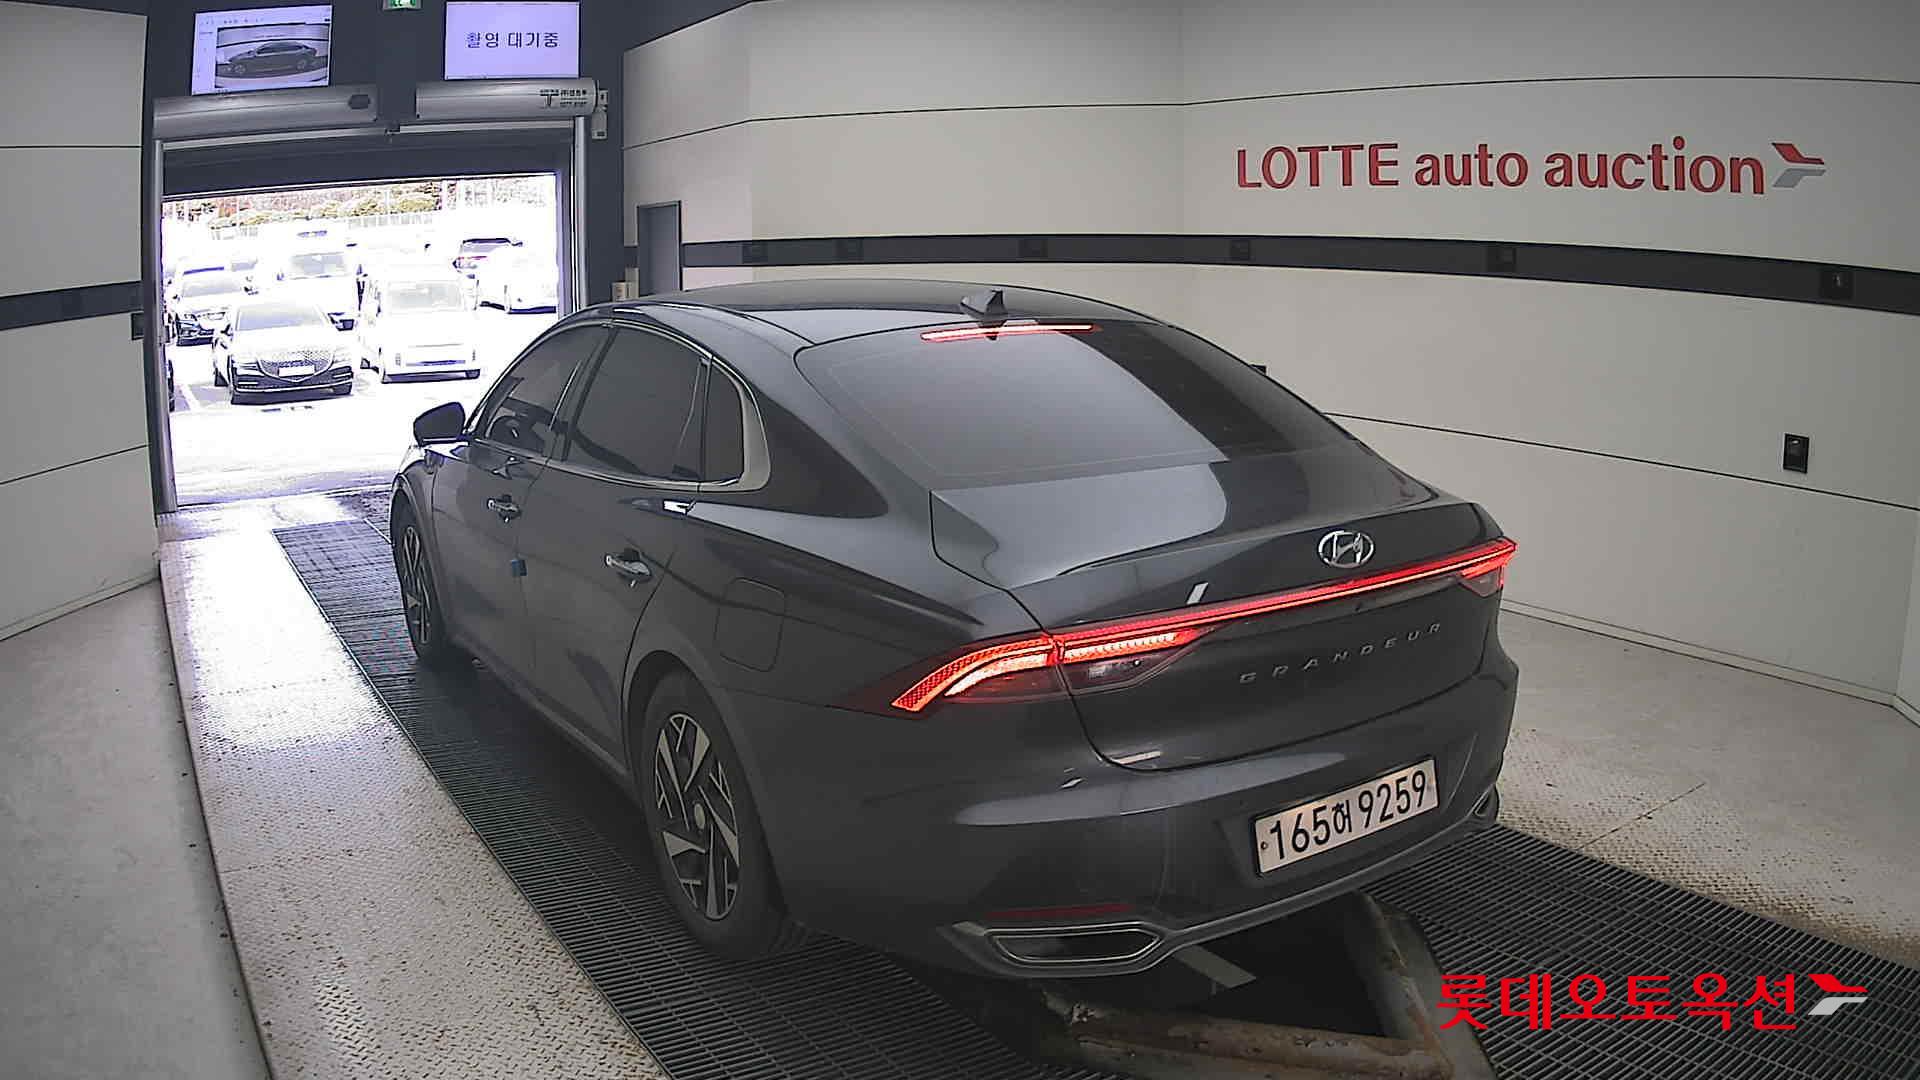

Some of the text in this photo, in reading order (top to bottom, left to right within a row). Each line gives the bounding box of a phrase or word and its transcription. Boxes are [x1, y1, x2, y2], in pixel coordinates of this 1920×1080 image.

[507, 32, 559, 49] 대기중
[1237, 136, 1766, 195] LOTTE auto auction
[1239, 622, 1441, 684] GRANDEUR
[1358, 770, 1427, 829] 9259
